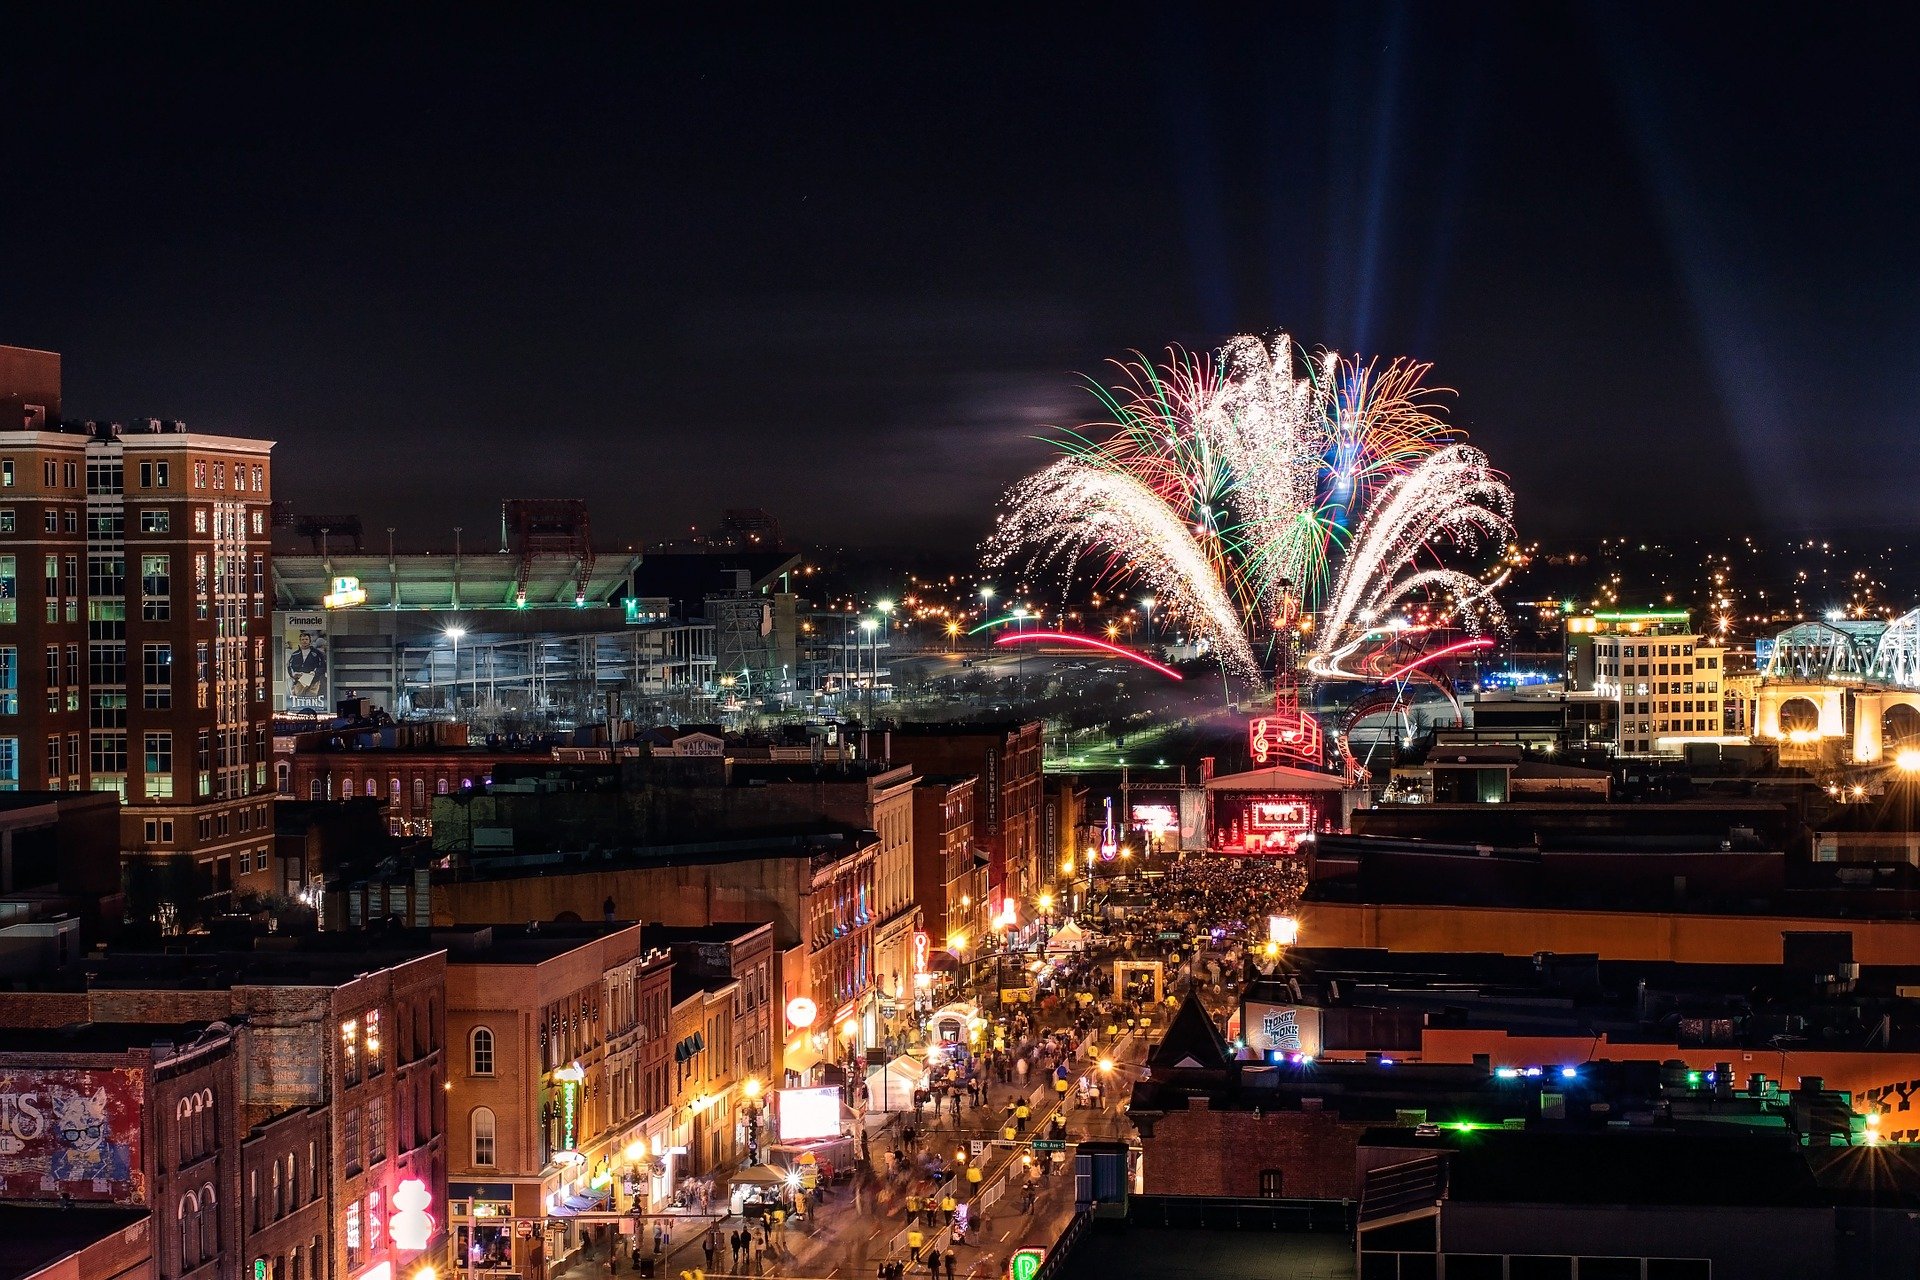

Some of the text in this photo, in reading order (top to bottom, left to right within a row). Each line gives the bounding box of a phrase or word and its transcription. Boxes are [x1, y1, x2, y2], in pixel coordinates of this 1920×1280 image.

[289, 616, 323, 625] Pinnacle
[289, 695, 325, 708] TITANS
[1264, 1012, 1296, 1034] HONKY
[1271, 1025, 1298, 1045] TONK
[1855, 1079, 1920, 1115] KY
